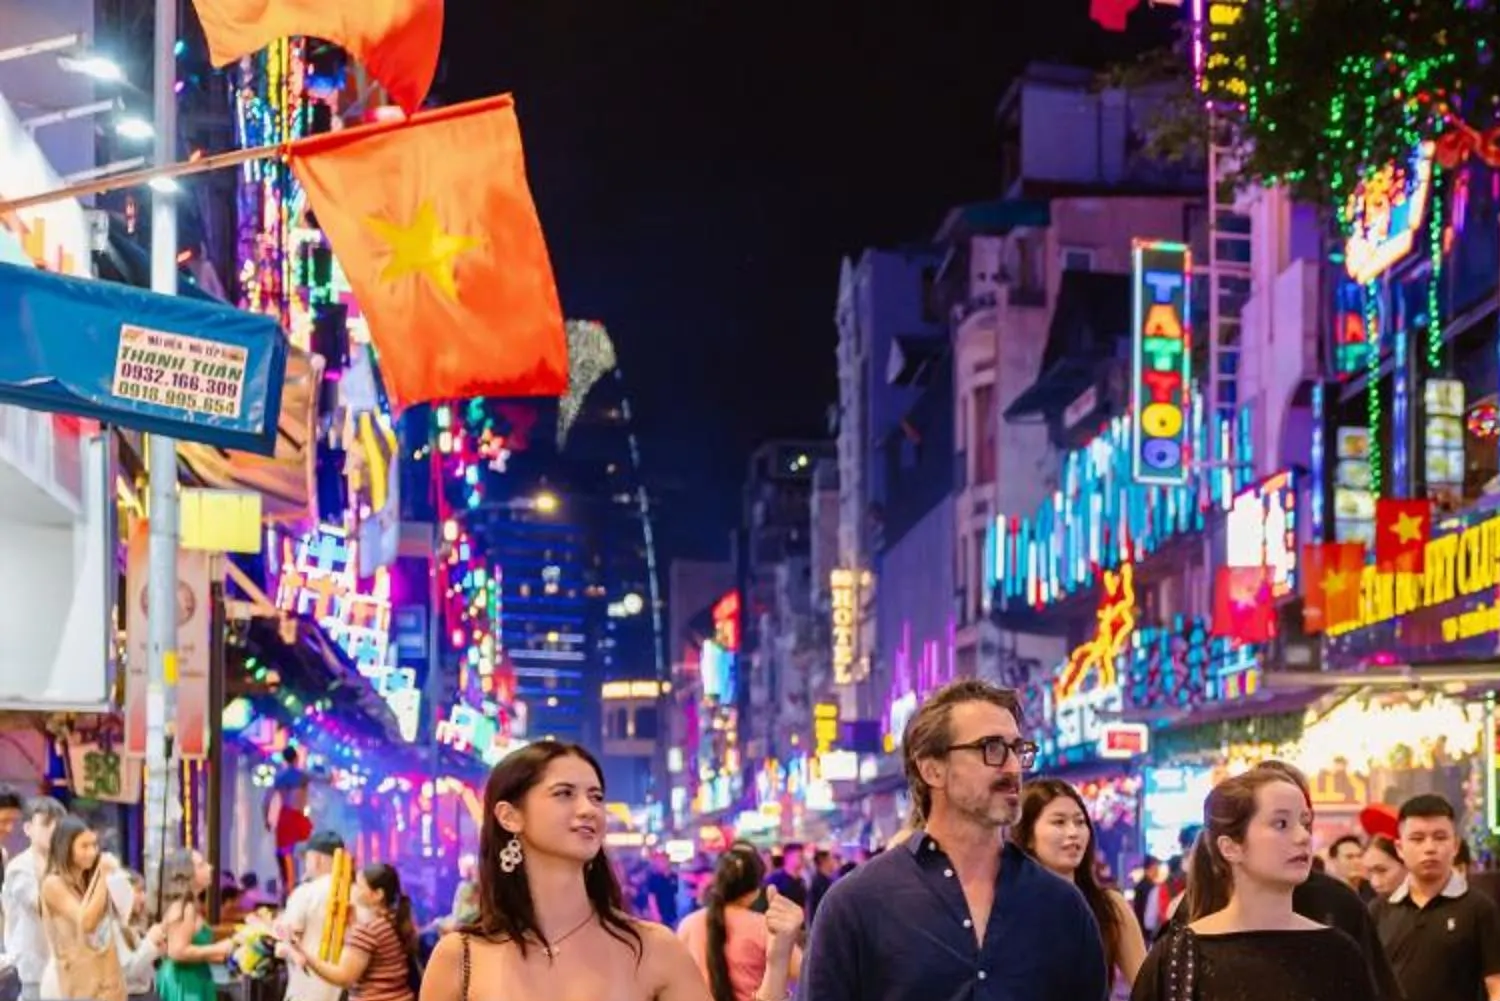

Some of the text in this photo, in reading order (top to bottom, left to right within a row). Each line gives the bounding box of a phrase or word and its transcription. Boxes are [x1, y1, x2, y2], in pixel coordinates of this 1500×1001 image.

[121, 345, 186, 371] THANH
[1141, 271, 1183, 469] TATTOO
[120, 362, 238, 398] 0932.166.309
